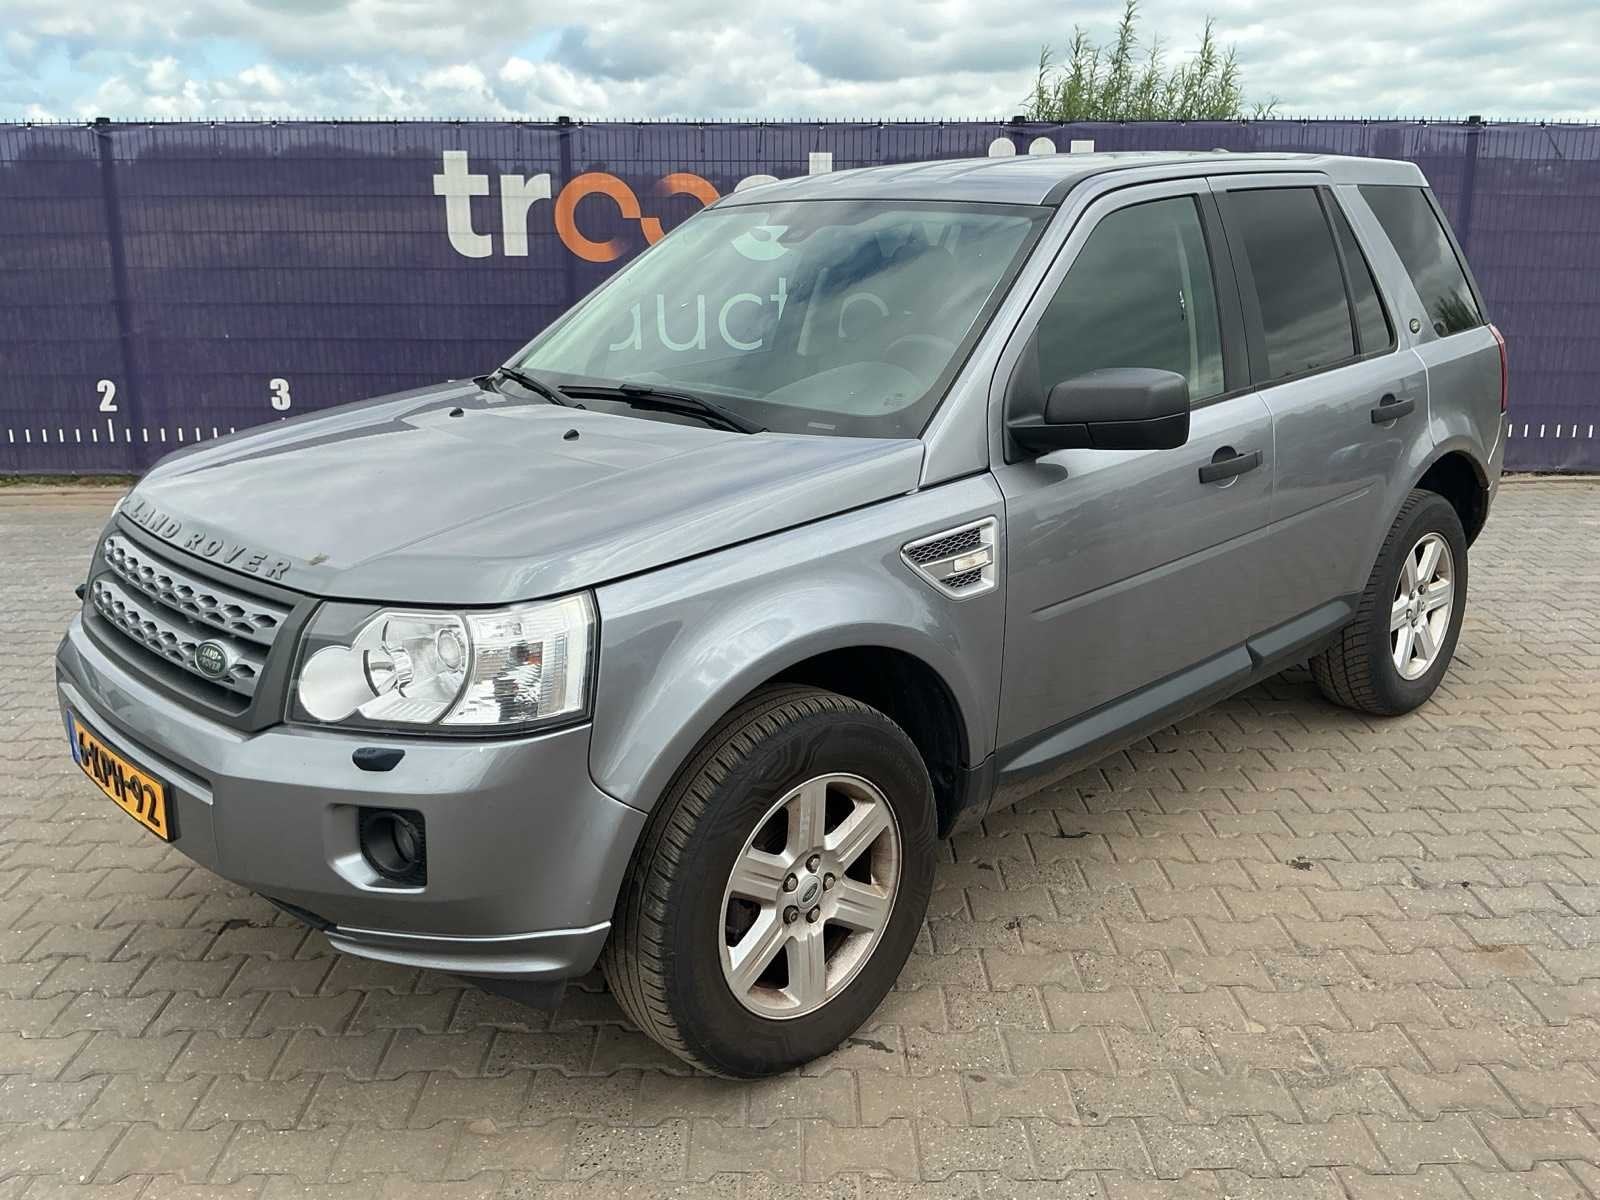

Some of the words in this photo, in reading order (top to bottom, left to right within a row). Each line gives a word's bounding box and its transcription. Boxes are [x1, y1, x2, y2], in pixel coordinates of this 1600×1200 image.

[97, 379, 118, 412] 2
[269, 378, 291, 410] 3
[130, 499, 182, 539] LAND
[184, 531, 292, 581] ROVER
